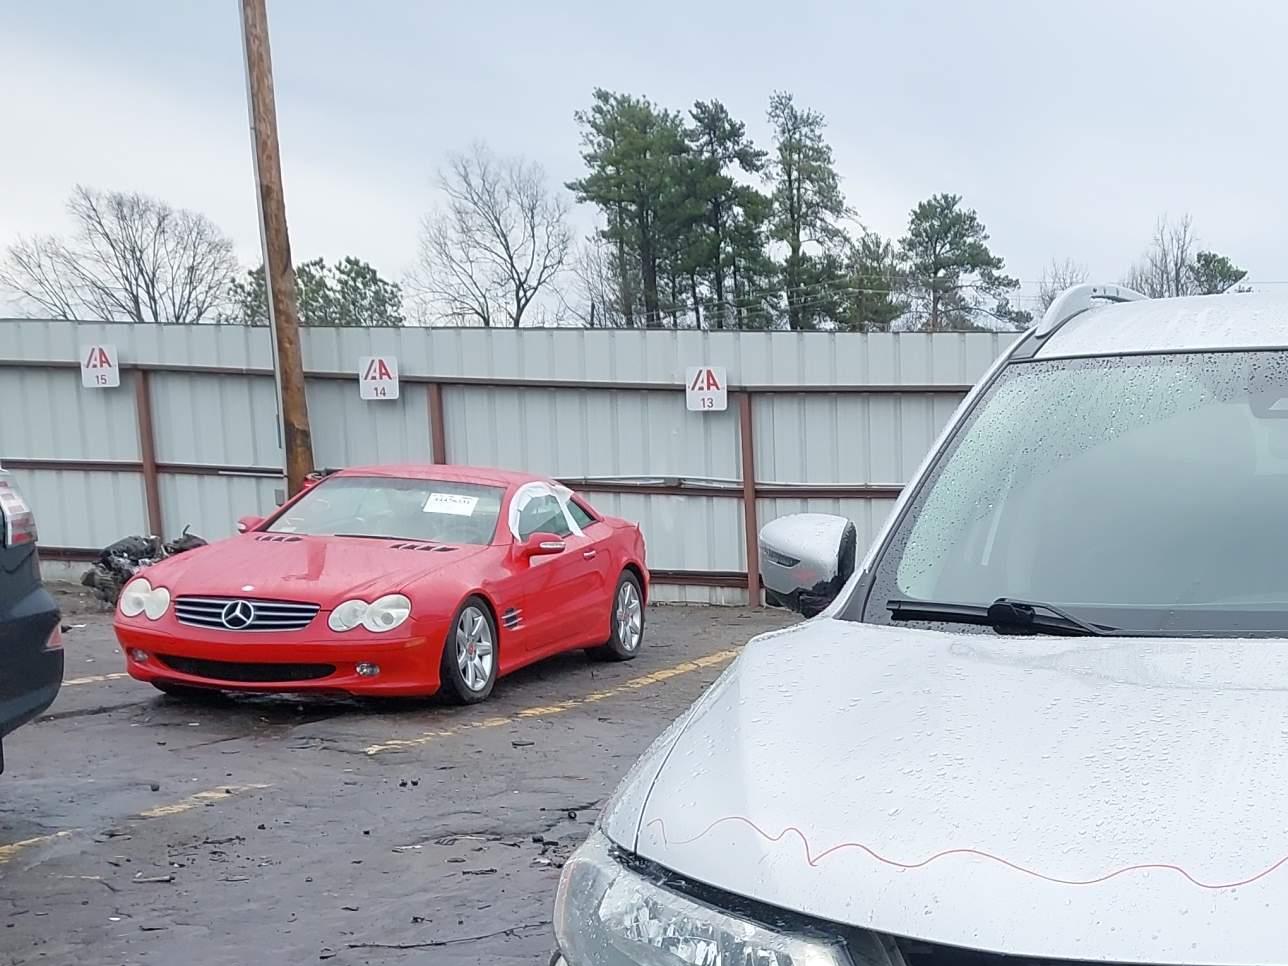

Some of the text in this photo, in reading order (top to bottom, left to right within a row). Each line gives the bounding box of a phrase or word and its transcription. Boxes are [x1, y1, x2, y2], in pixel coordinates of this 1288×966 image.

[95, 374, 107, 385] 15
[374, 387, 386, 397] 14
[701, 397, 714, 408] 13
